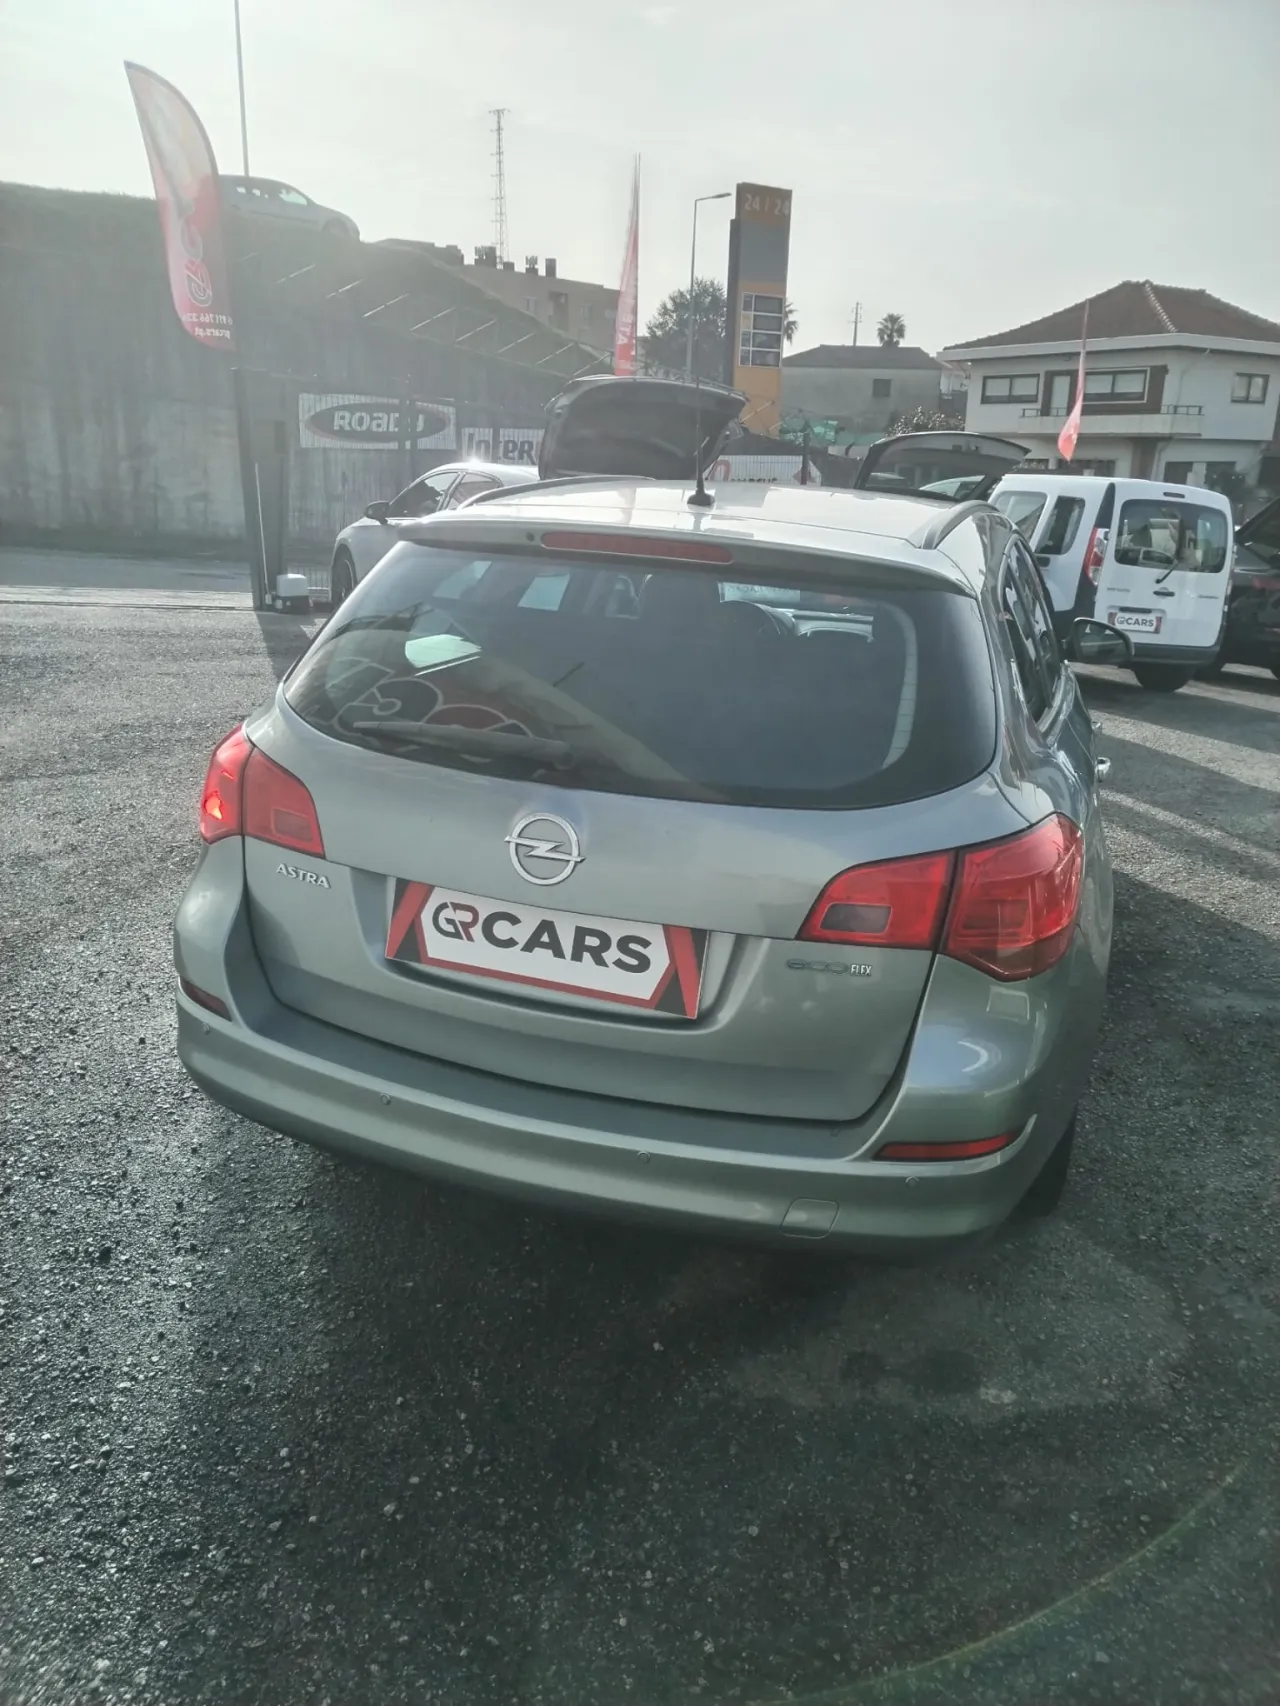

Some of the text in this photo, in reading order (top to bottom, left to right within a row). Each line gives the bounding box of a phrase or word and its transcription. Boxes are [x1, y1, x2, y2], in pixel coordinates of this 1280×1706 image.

[744, 193, 760, 212] 24
[775, 197, 791, 216] 24
[276, 863, 331, 889] ASTRA
